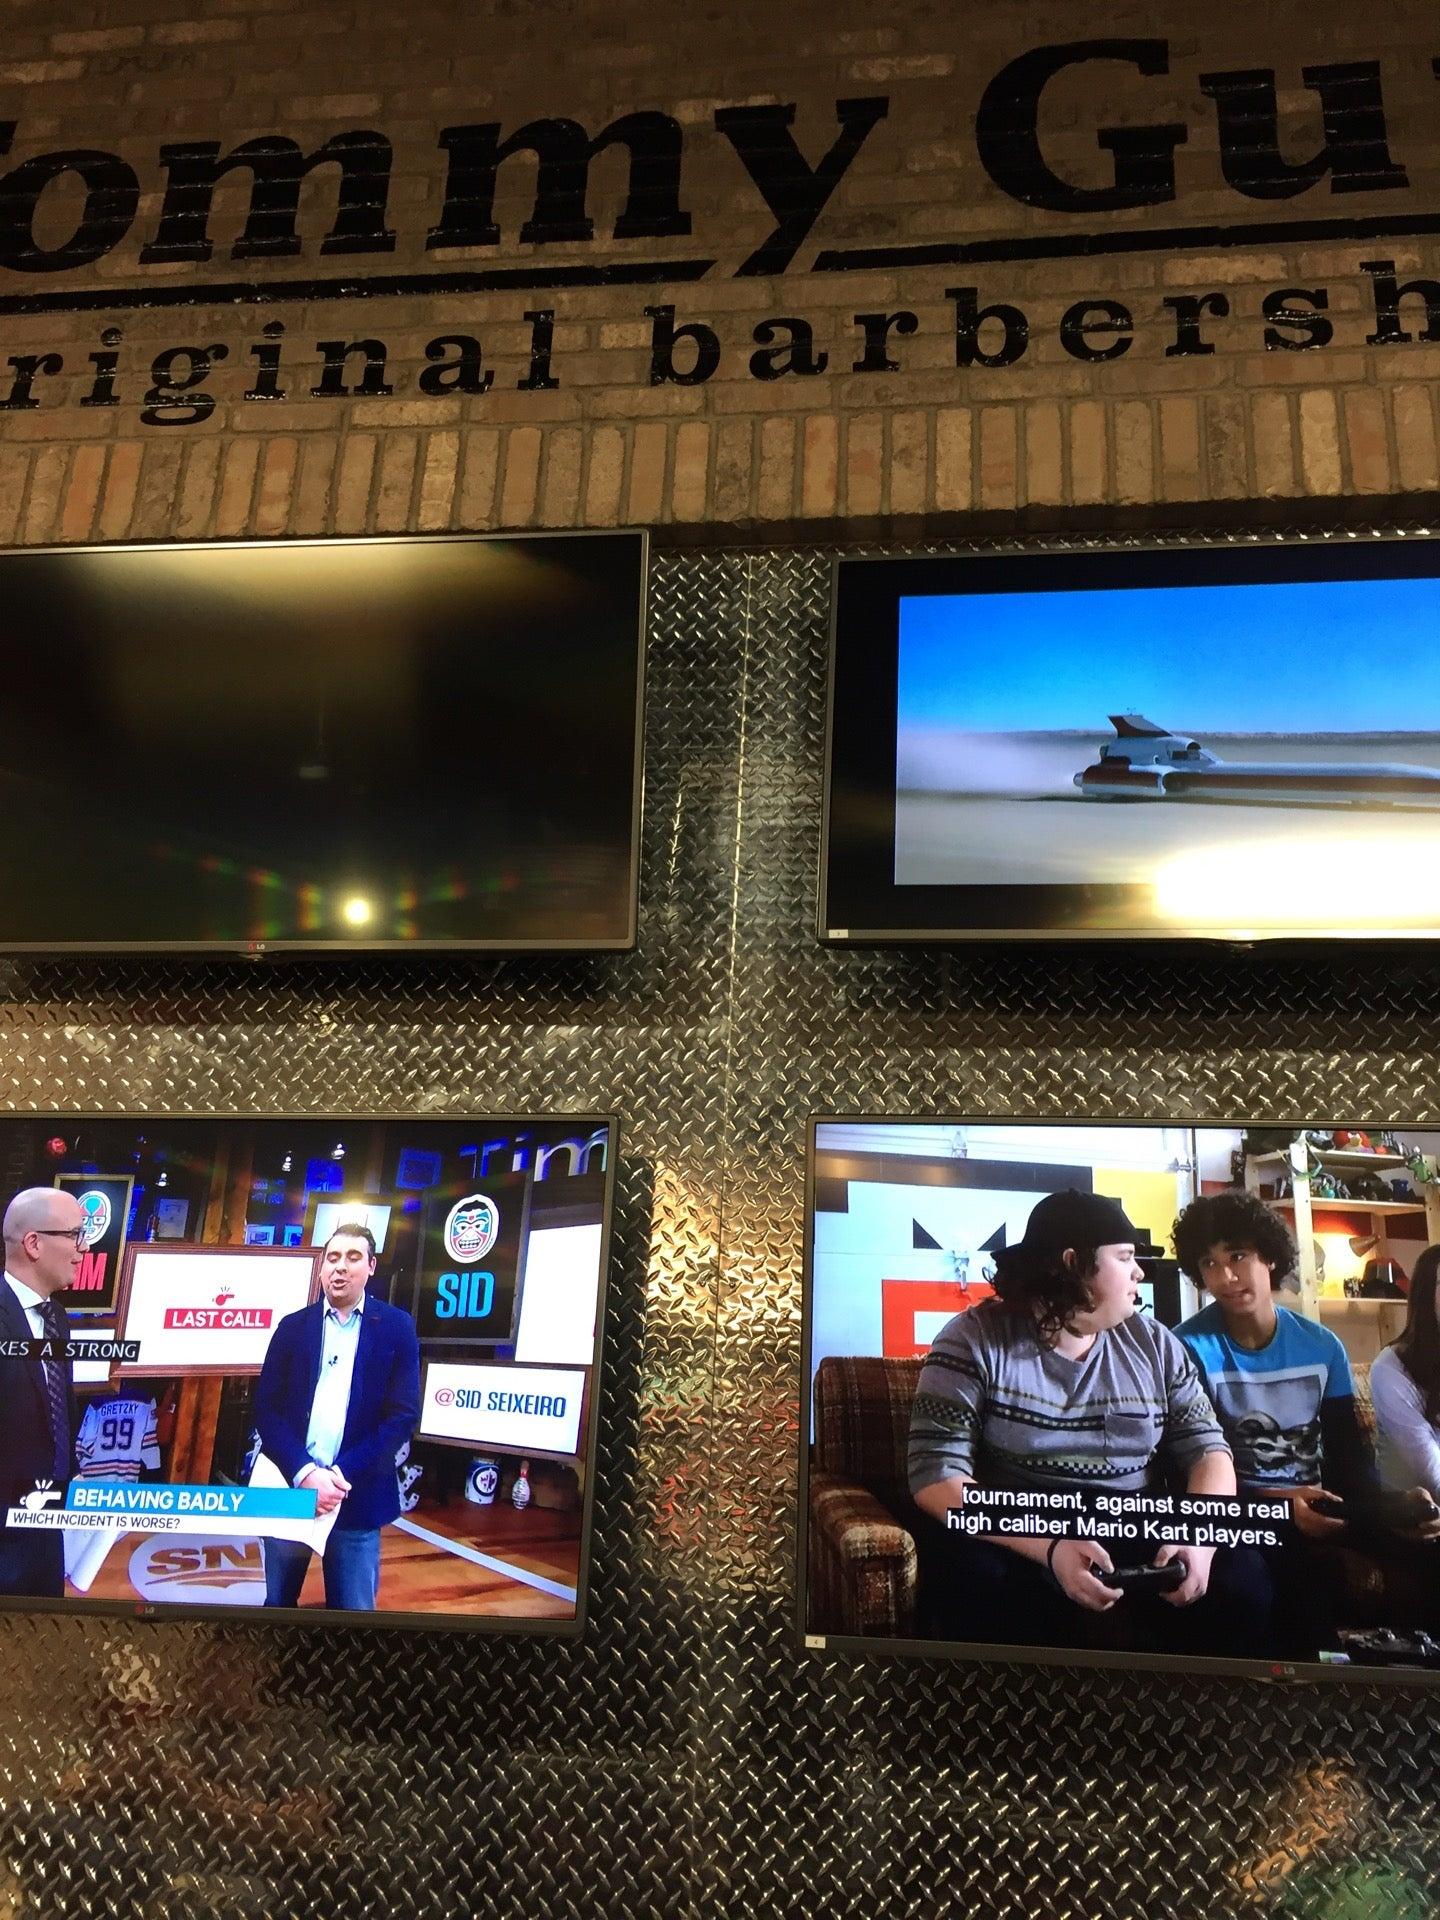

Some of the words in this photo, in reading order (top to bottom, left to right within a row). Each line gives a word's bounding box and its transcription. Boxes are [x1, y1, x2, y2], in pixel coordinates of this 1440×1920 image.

[0, 96, 889, 278] ommy
[975, 38, 1440, 213] Gu
[62, 1252, 108, 1291] IM
[436, 1271, 495, 1319] SID
[172, 1311, 215, 1327] LAST
[221, 1311, 265, 1327] CALL
[40, 1342, 53, 1357] A
[65, 1342, 137, 1359] STRONG
[101, 1403, 139, 1417] GRETZKY
[100, 1418, 135, 1450] 99
[73, 1488, 174, 1511] BEHAVING
[177, 1493, 245, 1512] BADLY
[962, 1486, 1088, 1512] tournament,
[1095, 1495, 1174, 1518] against
[1180, 1500, 1241, 1518] some
[1248, 1501, 1290, 1520] real
[13, 1513, 55, 1525] WHICH
[56, 1515, 114, 1528] INCIDENT
[116, 1517, 128, 1528] IS
[131, 1517, 181, 1530] WORSE?
[947, 1510, 992, 1537] high
[998, 1512, 1070, 1536] caliber
[1076, 1517, 1138, 1539] Mario
[1143, 1520, 1189, 1542] Kart
[1195, 1524, 1284, 1548] players.
[147, 1541, 262, 1575] SN
